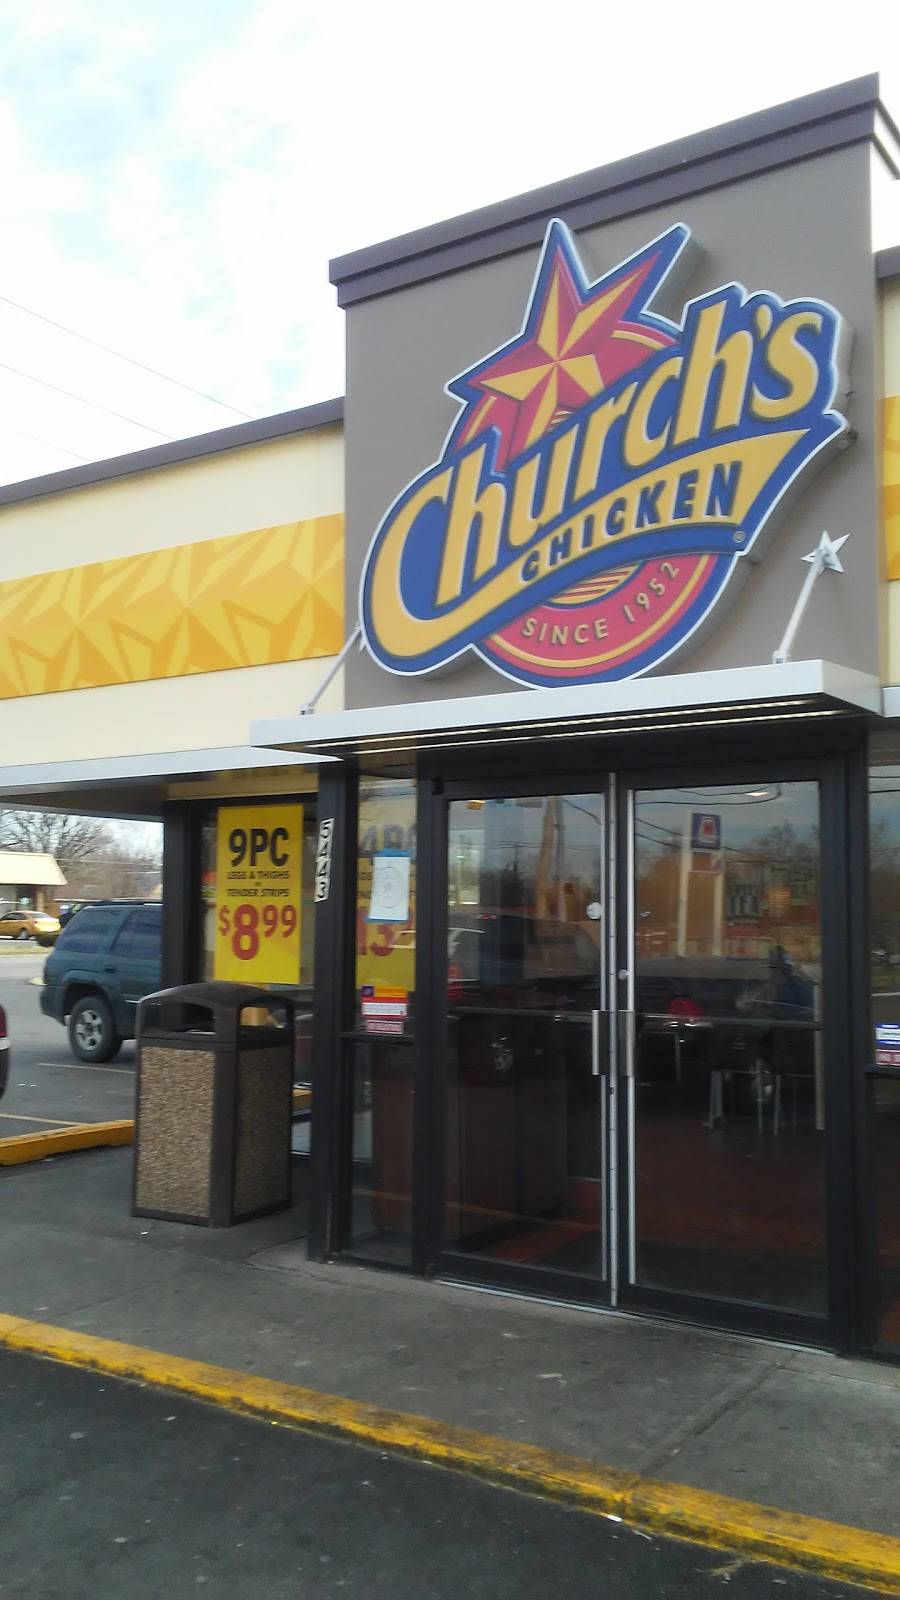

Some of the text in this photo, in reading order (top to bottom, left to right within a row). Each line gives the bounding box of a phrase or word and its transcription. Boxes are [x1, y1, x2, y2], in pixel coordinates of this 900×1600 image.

[371, 299, 823, 657] Church's
[518, 460, 740, 583] CHICKEN
[521, 561, 681, 645] SINCE 1952
[228, 827, 290, 868] 9PC
[226, 888, 290, 897] TENDER STRIPS
